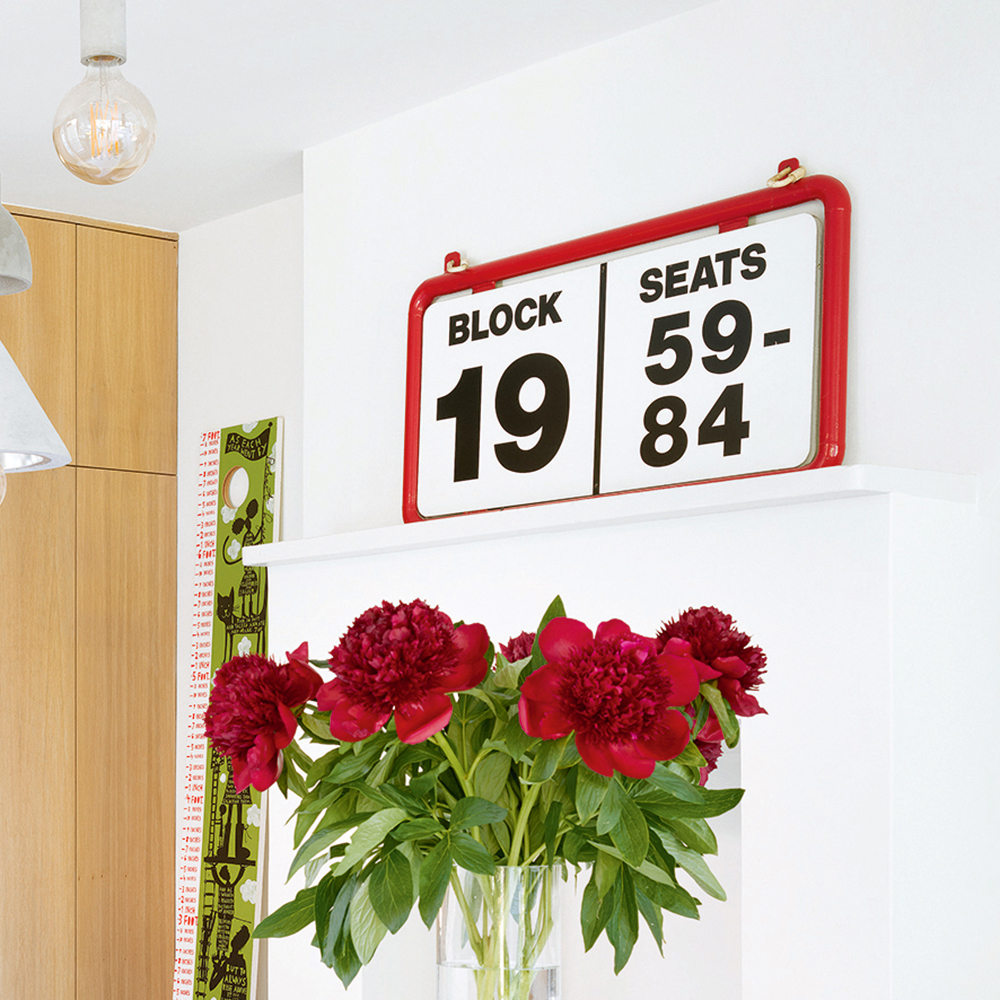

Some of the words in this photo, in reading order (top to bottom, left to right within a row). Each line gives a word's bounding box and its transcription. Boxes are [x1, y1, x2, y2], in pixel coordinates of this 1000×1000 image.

[639, 243, 767, 303] SEATS
[448, 290, 563, 346] BLOCK
[436, 352, 571, 483] 19
[639, 382, 750, 468] 84
